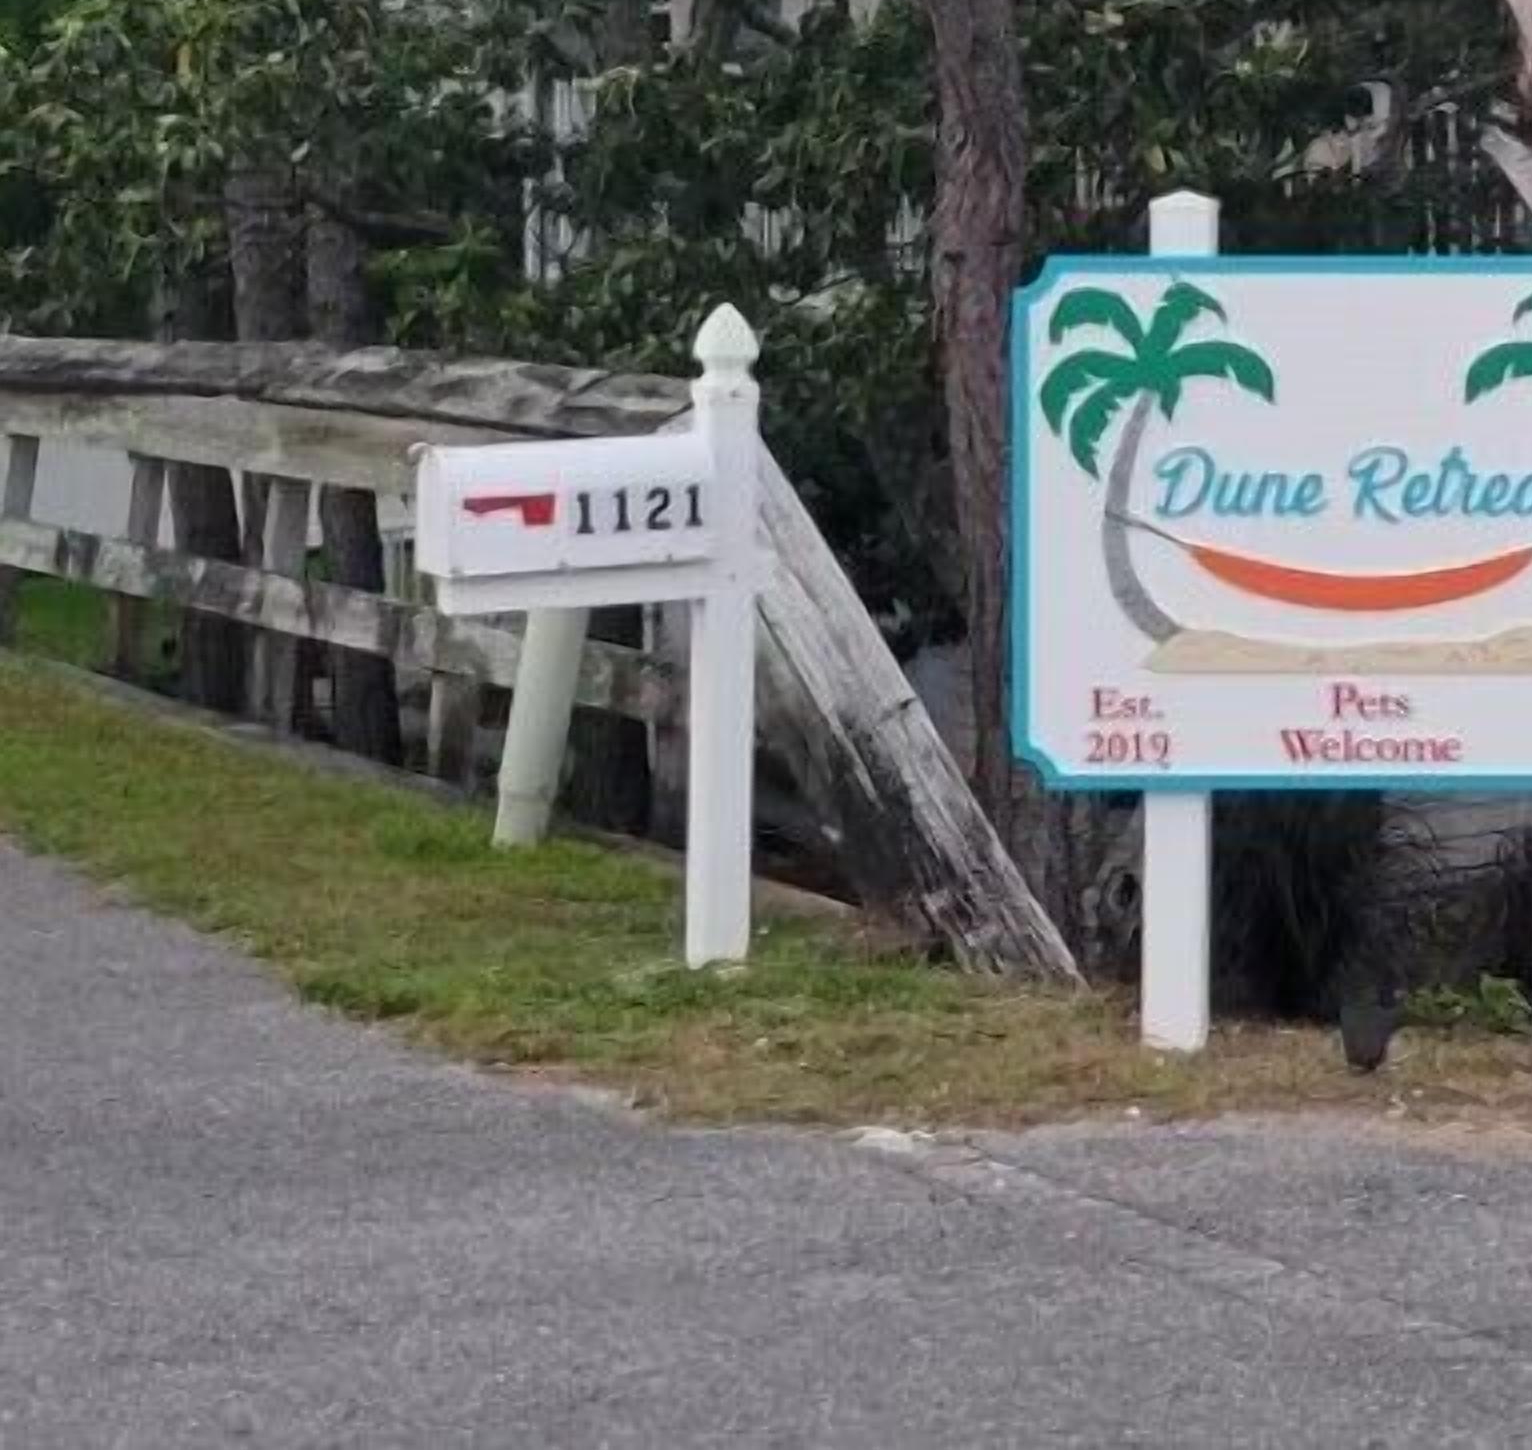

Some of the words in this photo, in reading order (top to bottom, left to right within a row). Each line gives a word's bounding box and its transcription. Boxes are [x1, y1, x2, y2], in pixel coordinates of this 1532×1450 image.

[1154, 446, 1328, 518] Dune
[576, 484, 704, 535] 1121
[1092, 688, 1165, 719] Est.
[1331, 682, 1409, 721] Pets
[1087, 732, 1170, 768] 2019
[1281, 729, 1461, 762] Welcome
